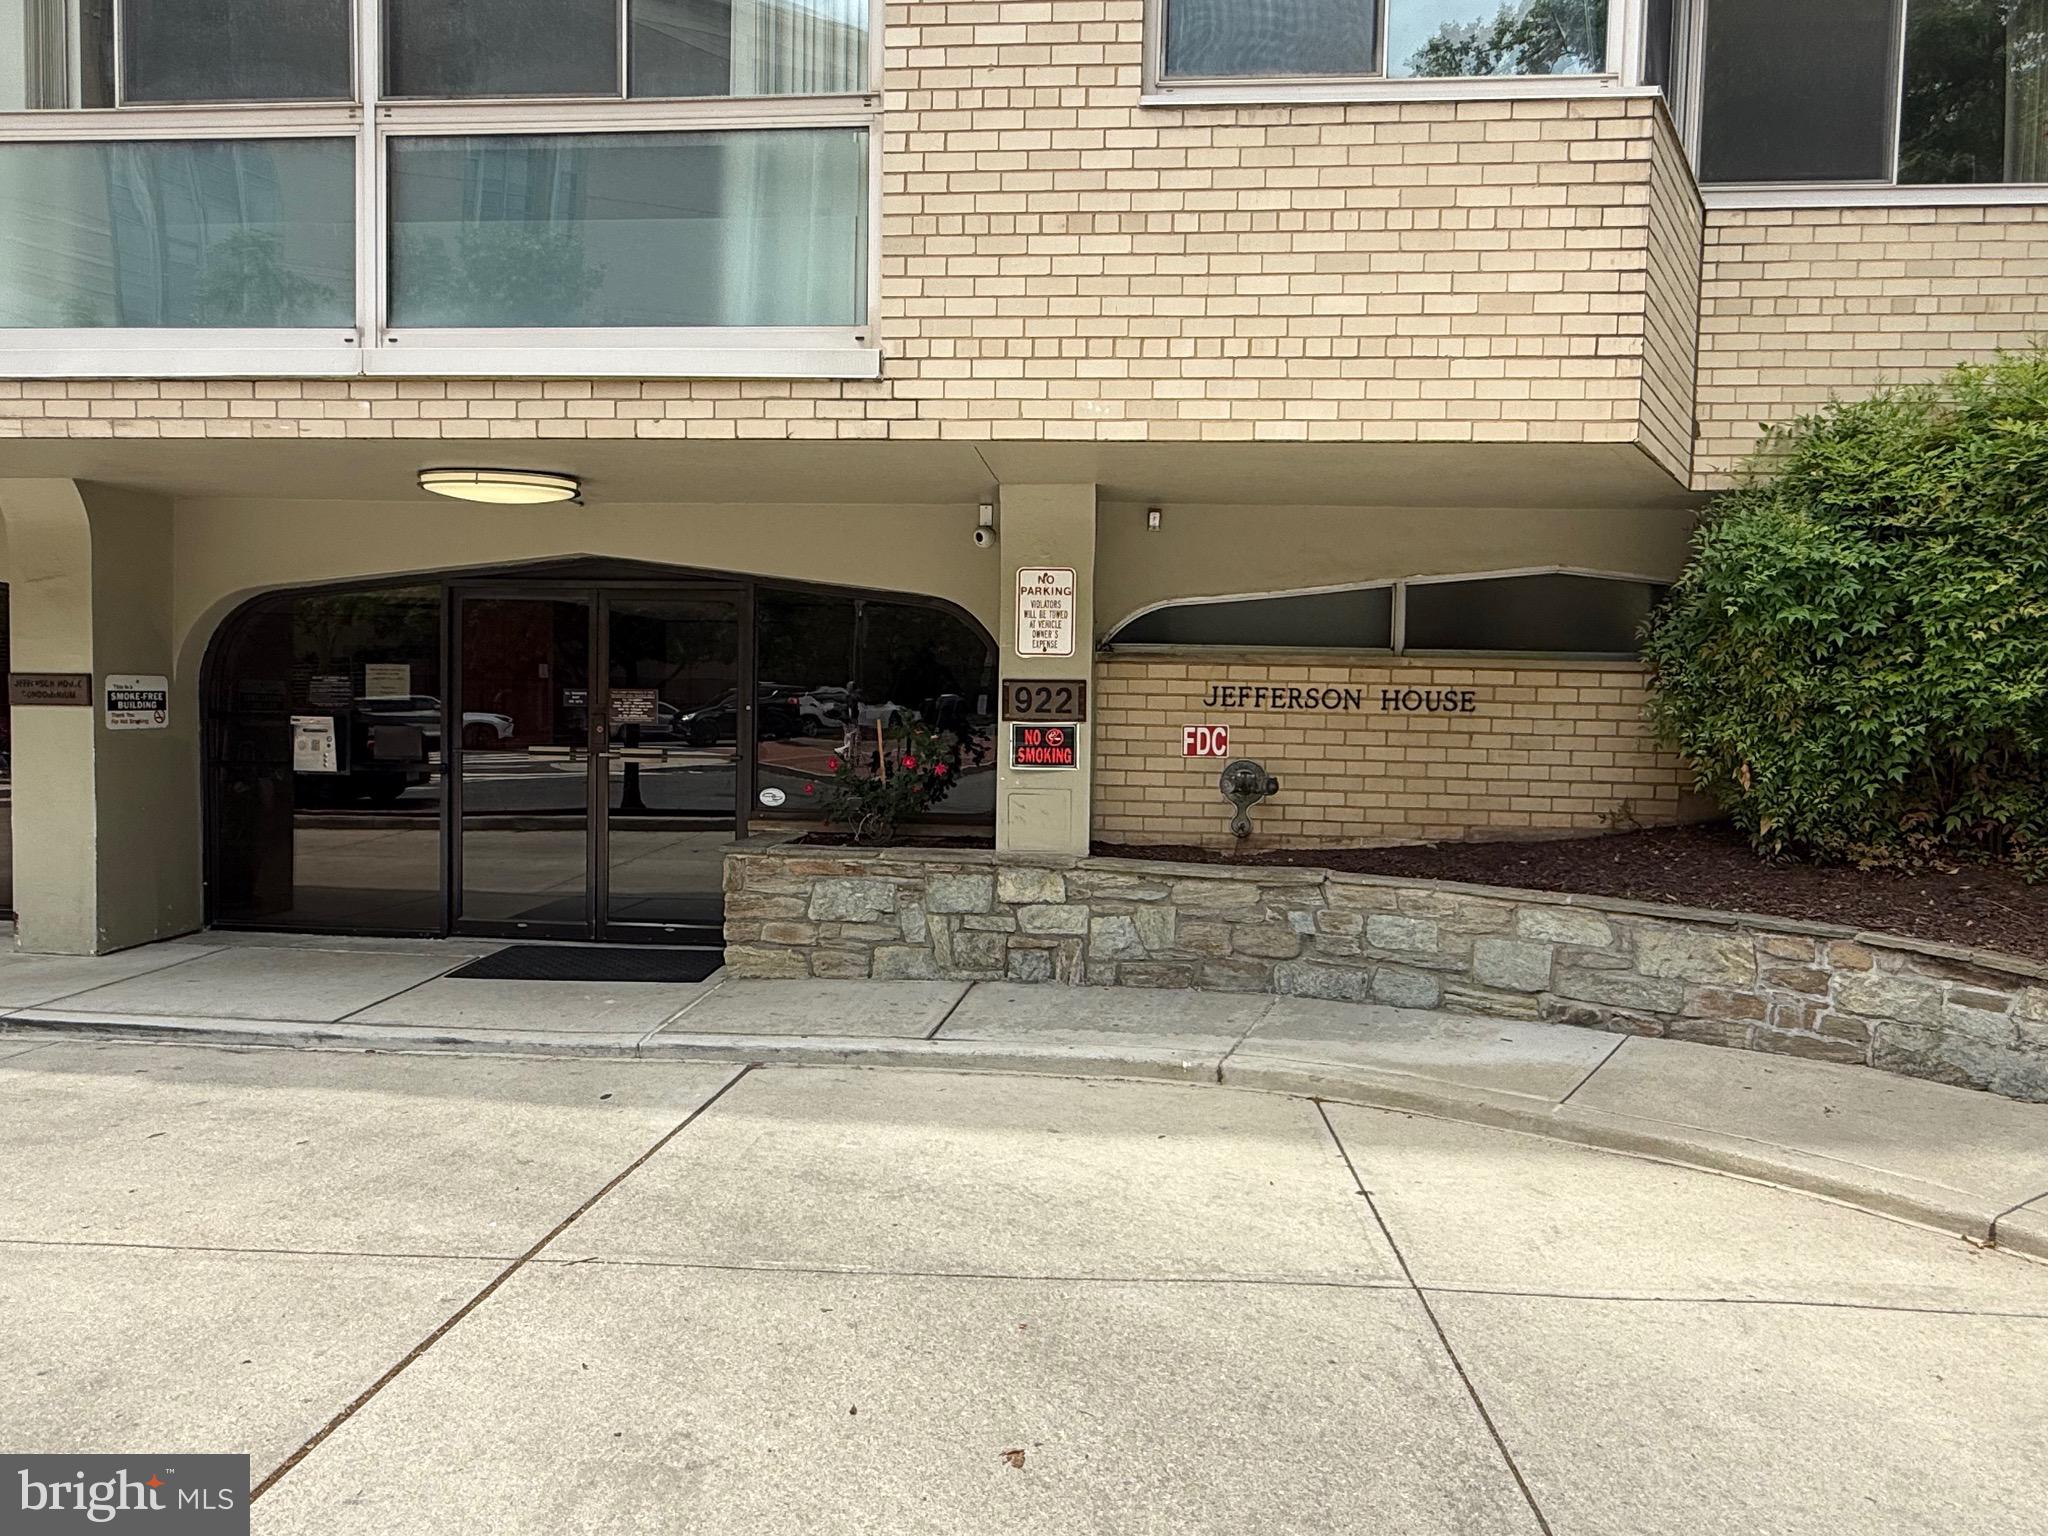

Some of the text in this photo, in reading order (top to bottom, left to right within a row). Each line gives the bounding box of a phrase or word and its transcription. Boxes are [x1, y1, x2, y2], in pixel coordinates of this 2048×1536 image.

[1038, 575, 1055, 584] NO
[1020, 587, 1072, 596] PARKING
[1031, 600, 1062, 609] VIOLATORS
[1024, 610, 1068, 619] WILL BE TOWED
[1029, 620, 1062, 629] AT VEHICLE
[1032, 630, 1059, 639] OWNER'S
[1032, 640, 1058, 649] EXPENSE
[110, 692, 164, 701] SMOKE-FREE
[1015, 686, 1073, 714] 922
[1203, 685, 1476, 713] JEFFERSON HOUSE
[118, 701, 158, 710] BUILDING
[1024, 729, 1042, 745] NO
[1183, 726, 1227, 756] FDC
[1017, 747, 1072, 764] SMOKING
